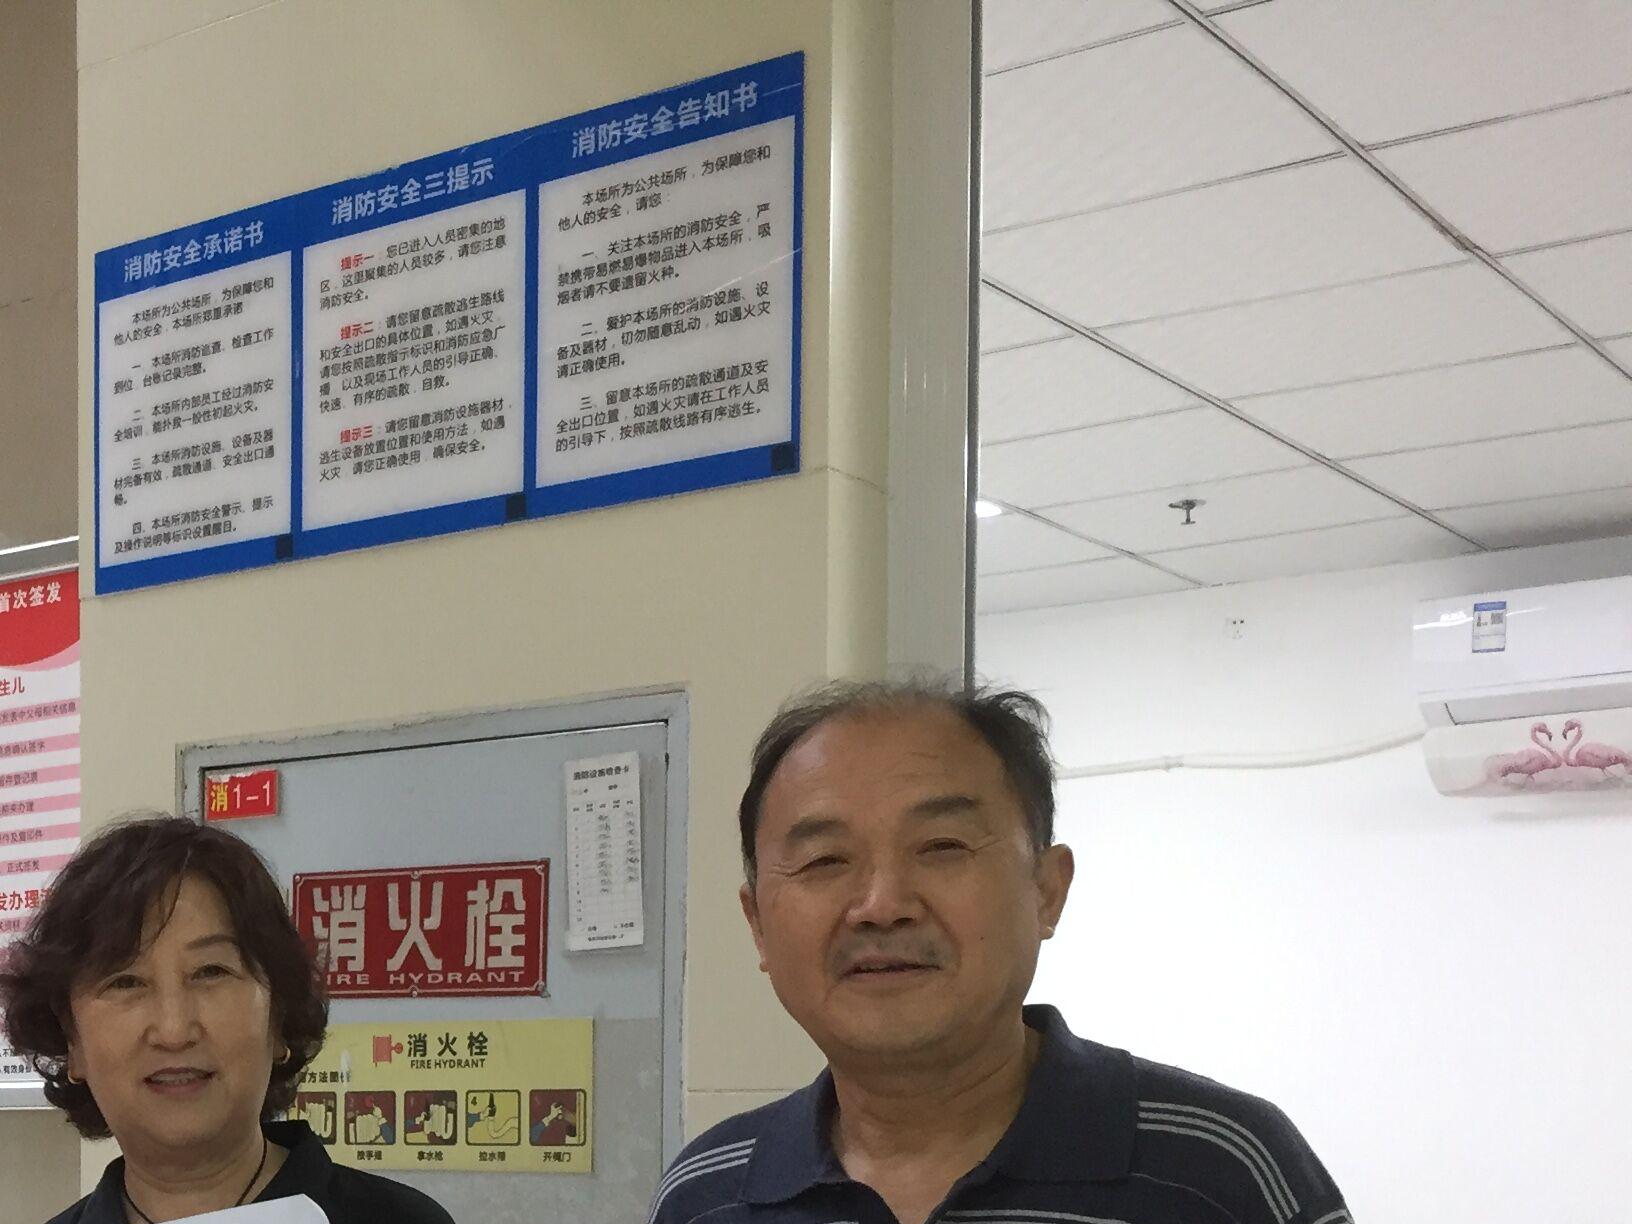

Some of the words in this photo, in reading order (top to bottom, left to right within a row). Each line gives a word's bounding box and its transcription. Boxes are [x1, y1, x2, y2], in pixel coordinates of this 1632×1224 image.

[571, 80, 759, 158] 消防安全告知书
[331, 157, 494, 225] 消防安全三提示
[123, 220, 265, 283] 消防安全承诺书
[557, 352, 625, 379] 请正确使用。
[312, 879, 526, 972] 消火栓
[319, 972, 370, 986] IRE
[389, 971, 525, 985] HYDRANT
[407, 1031, 489, 1058] 消火栓
[410, 1058, 432, 1070] FIRE
[434, 1058, 486, 1070] HYDRANT
